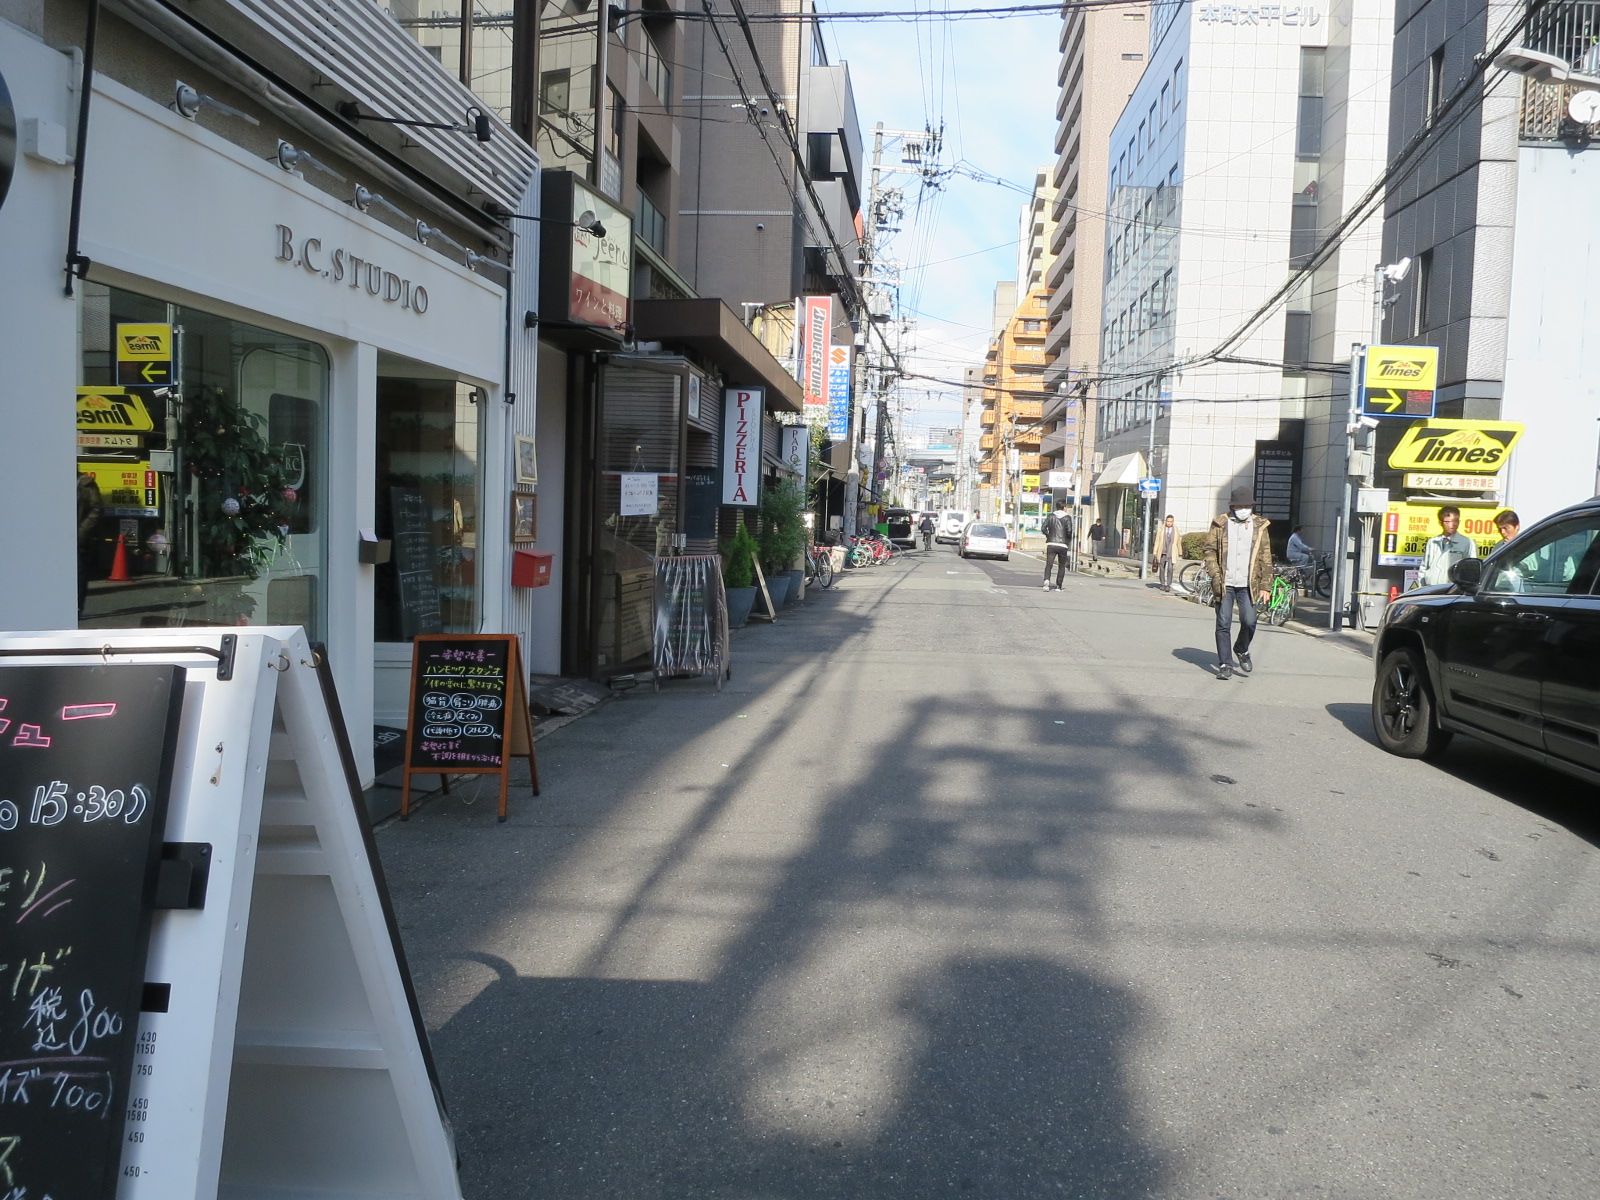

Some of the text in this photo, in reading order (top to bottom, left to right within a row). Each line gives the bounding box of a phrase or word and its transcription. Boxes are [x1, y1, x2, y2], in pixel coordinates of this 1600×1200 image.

[1199, 4, 1320, 27] 本町太平ビル
[575, 288, 625, 323] ワインと料理
[1378, 360, 1422, 377] Times
[733, 392, 751, 502] PIZZERIA
[1411, 432, 1504, 464] Times
[1464, 518, 1493, 535] 900
[468, 665, 501, 676] スタジオ
[453, 696, 474, 708] 肩こり
[458, 712, 480, 720] むくみ
[468, 726, 490, 734] ストレス
[140, 1032, 157, 1042] 430
[136, 1044, 156, 1055] 1150
[137, 1065, 153, 1076] 750
[132, 1099, 149, 1110] 450
[127, 1110, 147, 1122] 1580
[128, 1132, 145, 1143] 450
